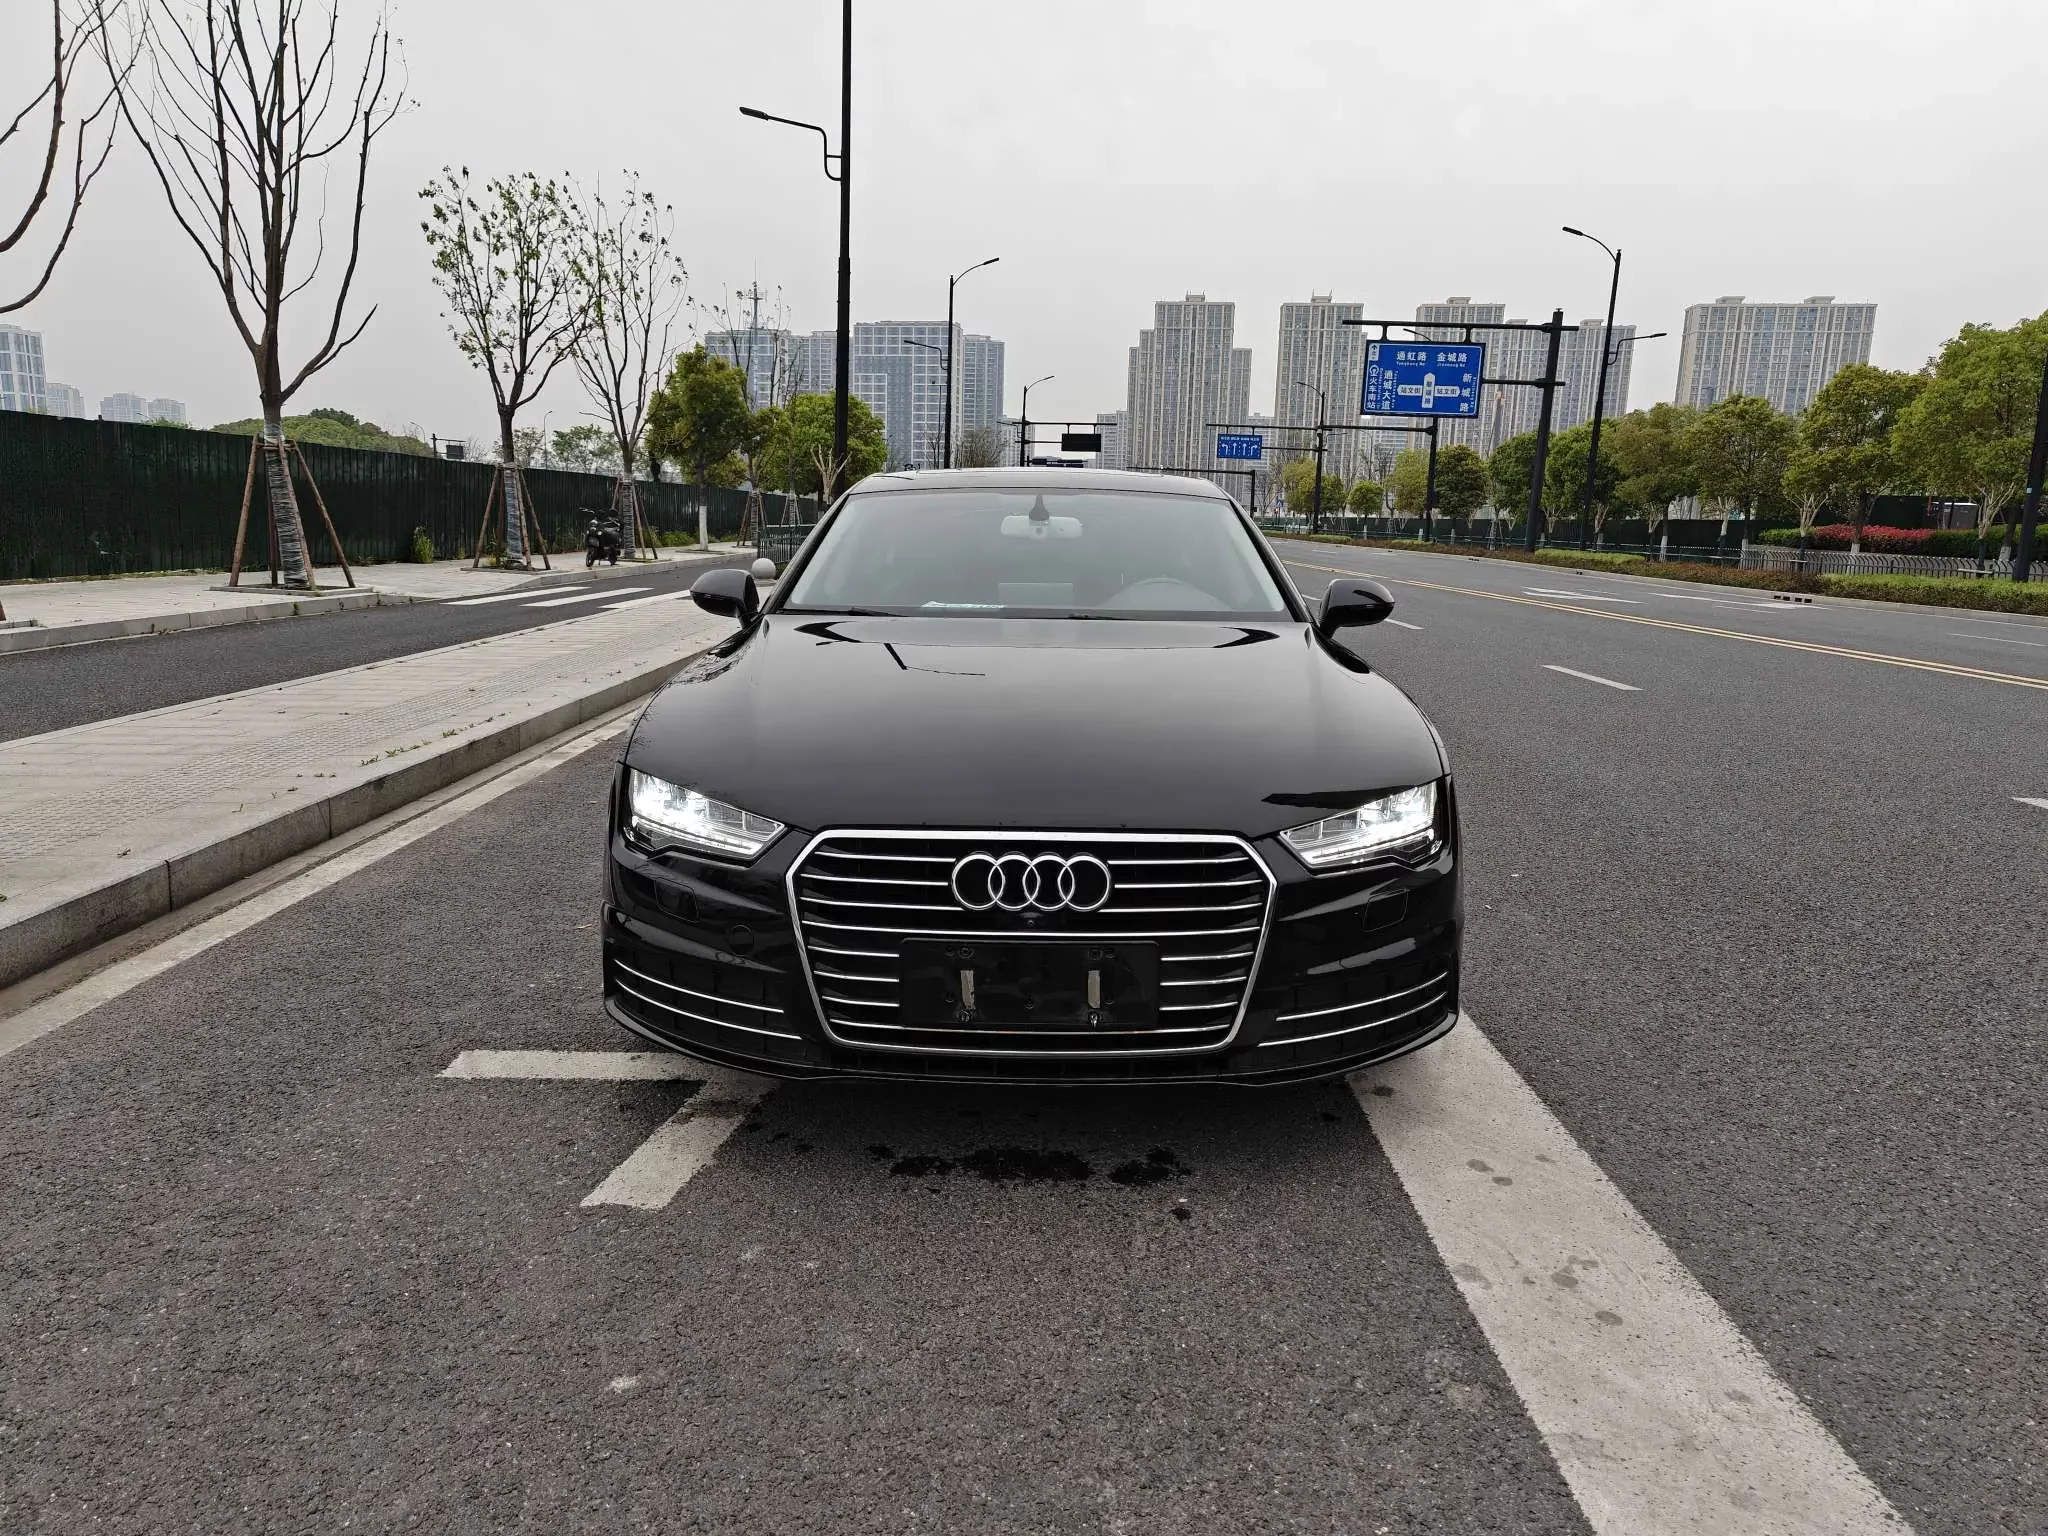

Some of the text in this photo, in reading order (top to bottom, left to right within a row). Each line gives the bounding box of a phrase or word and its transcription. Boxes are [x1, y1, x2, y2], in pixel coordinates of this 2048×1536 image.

[1437, 352, 1468, 362] 金城路
[1367, 377, 1378, 408] 火车南站
[1382, 370, 1393, 410] 通城大道
[1460, 373, 1473, 412] 新城路
